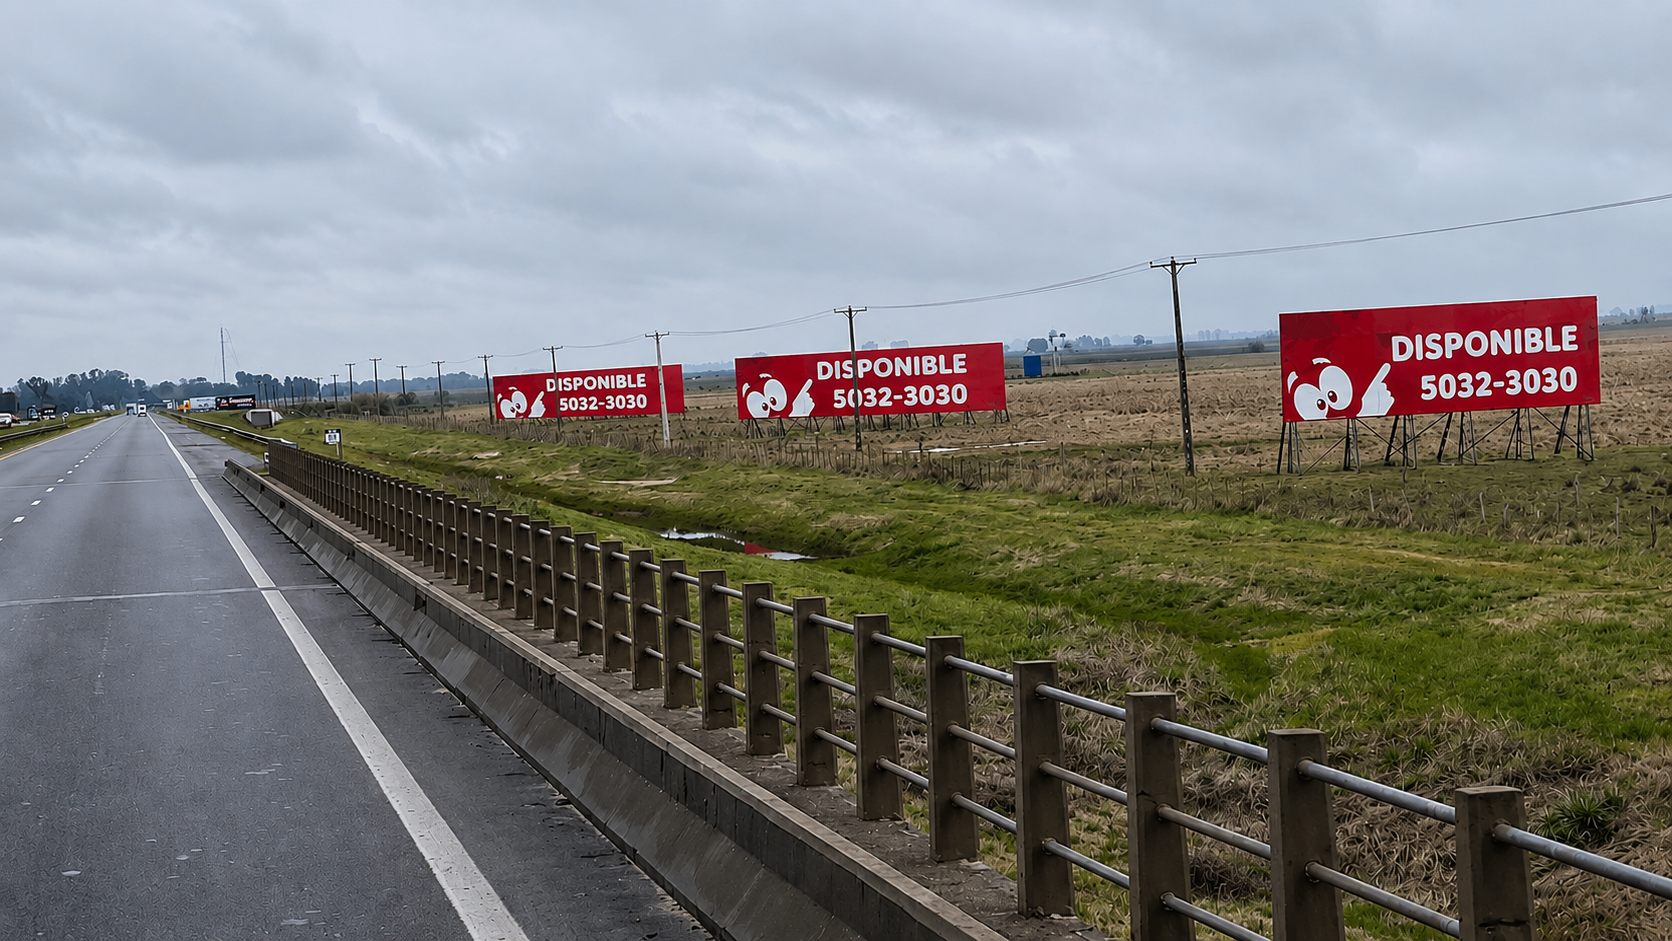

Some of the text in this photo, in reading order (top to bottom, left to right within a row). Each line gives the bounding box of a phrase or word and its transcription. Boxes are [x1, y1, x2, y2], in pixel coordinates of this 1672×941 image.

[1391, 324, 1579, 362] DISPONIBLE
[817, 353, 968, 381] DISPONIBLE
[545, 373, 647, 392] DISPONIBLE
[833, 383, 968, 409] 5032-3030
[1421, 365, 1578, 401] 5032-3030
[559, 393, 648, 412] 5032-3030
